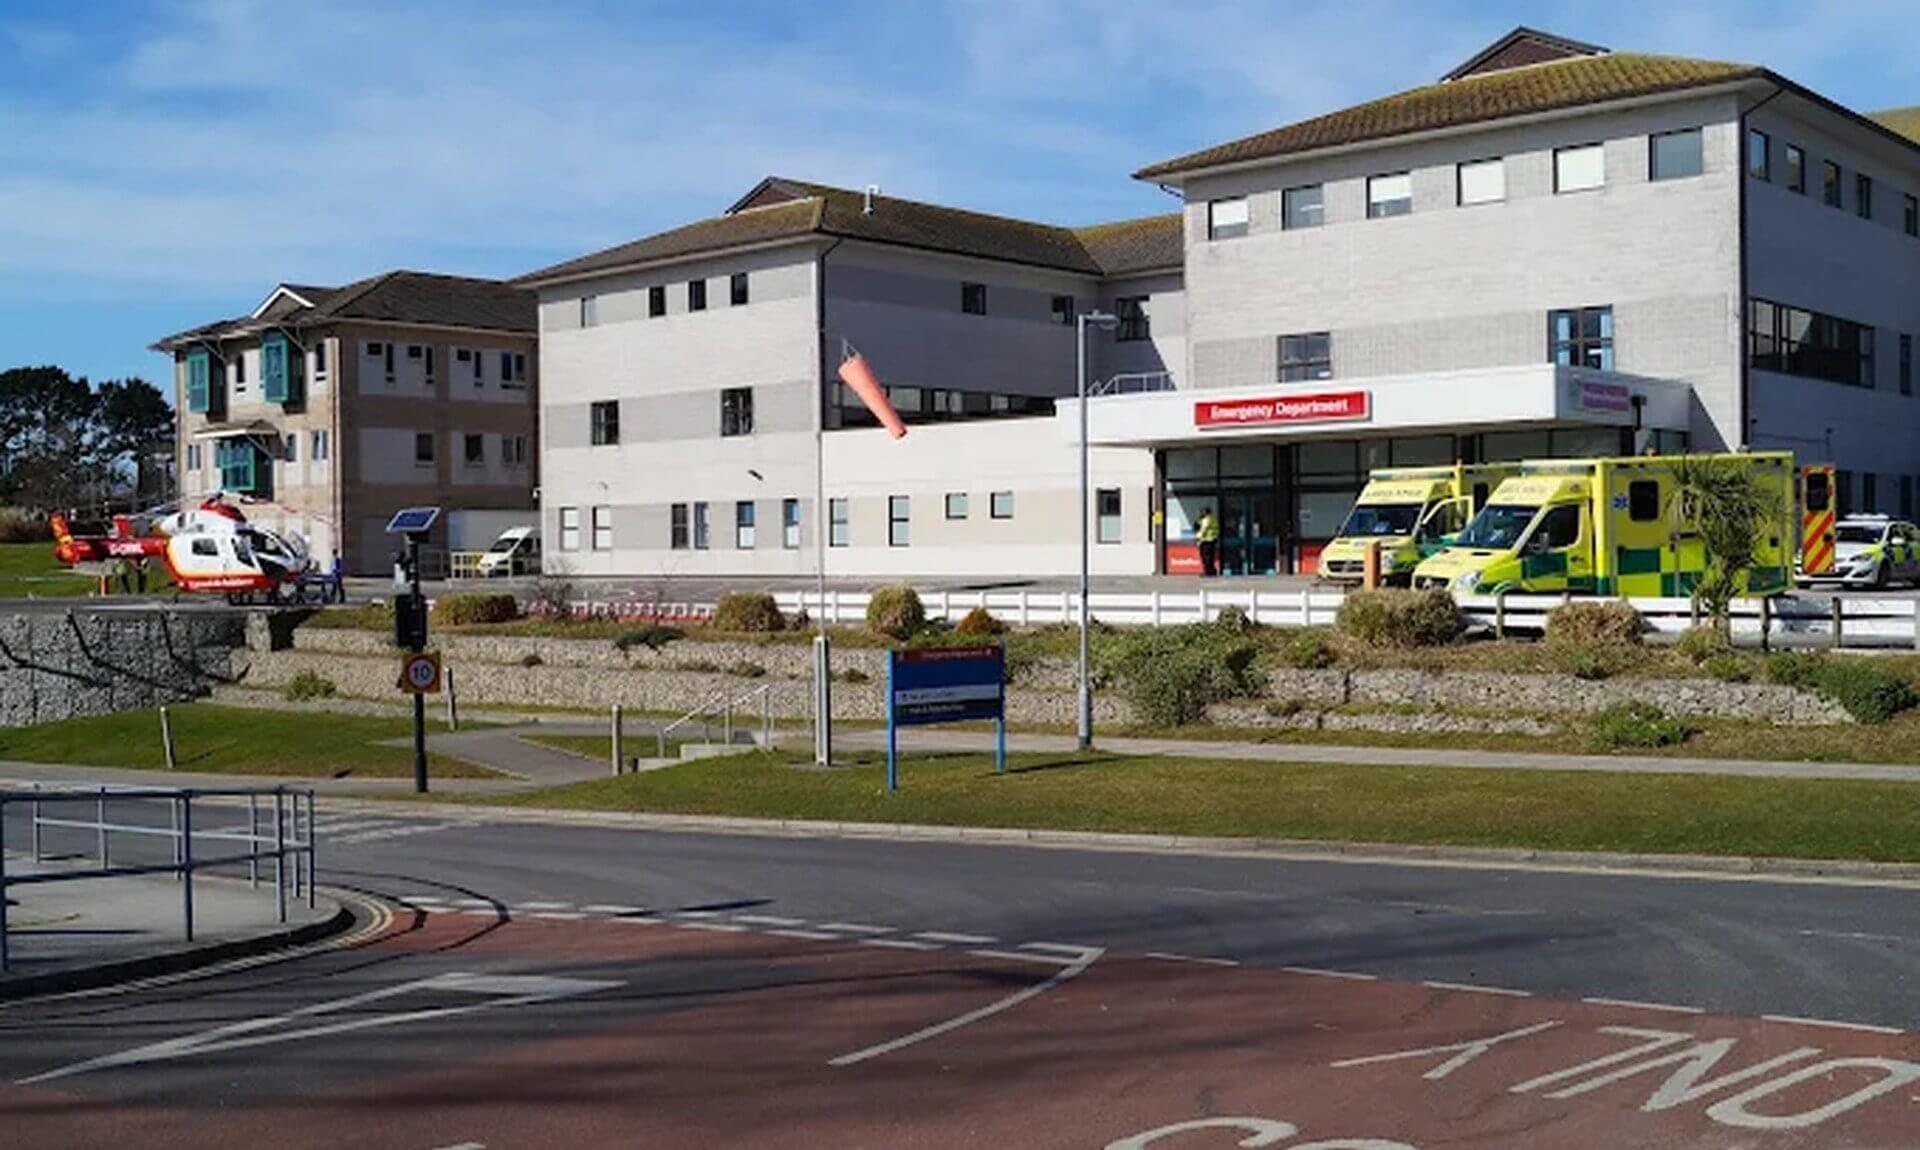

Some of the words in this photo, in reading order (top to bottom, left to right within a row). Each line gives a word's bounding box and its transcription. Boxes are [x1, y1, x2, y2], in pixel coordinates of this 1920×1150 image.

[1211, 403, 1274, 420] Emergency
[1275, 399, 1349, 417] Department
[413, 663, 432, 681] 10
[1329, 1020, 1920, 1128] ONLY
